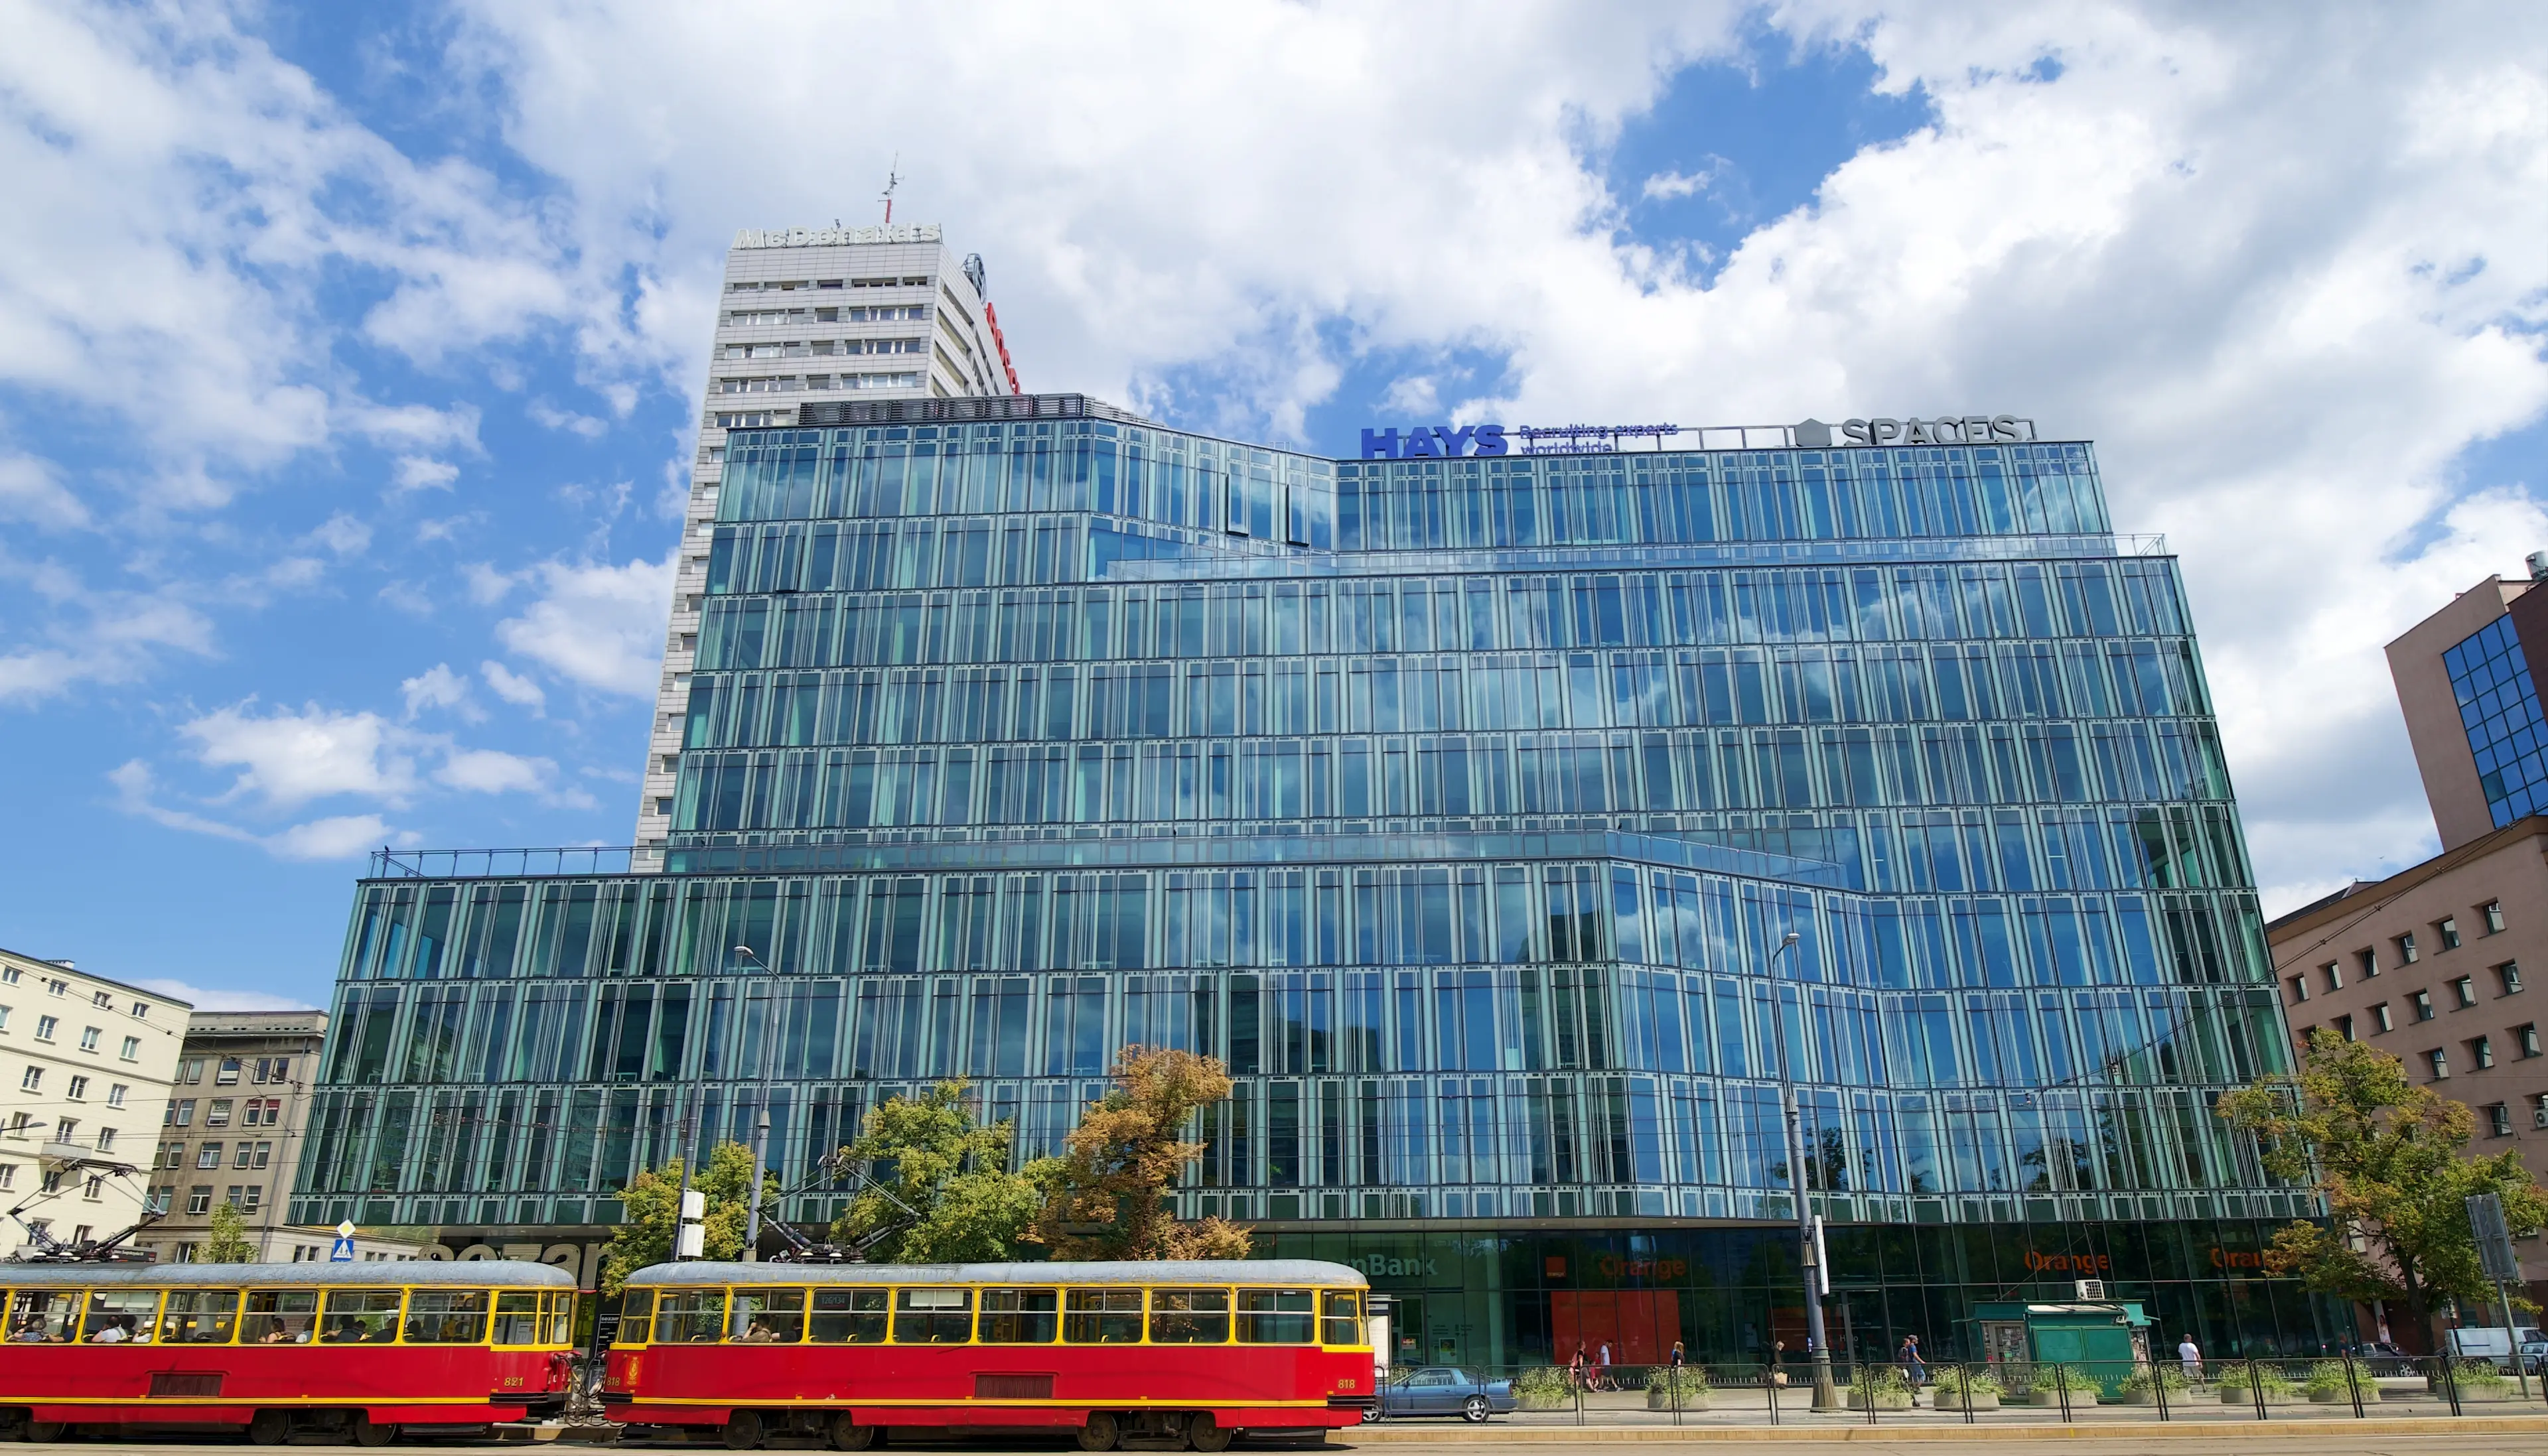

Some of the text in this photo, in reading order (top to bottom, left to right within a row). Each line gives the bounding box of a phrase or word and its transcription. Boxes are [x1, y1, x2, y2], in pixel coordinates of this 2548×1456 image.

[1520, 422, 1678, 439] Recruiting experts
[1842, 415, 2022, 446] SPACES
[1361, 425, 1508, 460] HAYS
[1520, 440, 1612, 456] worldwide
[1600, 1255, 1687, 1280] Orange
[2024, 1251, 2109, 1274] Orange
[606, 1377, 620, 1386] 818
[1338, 1379, 1356, 1389] 818
